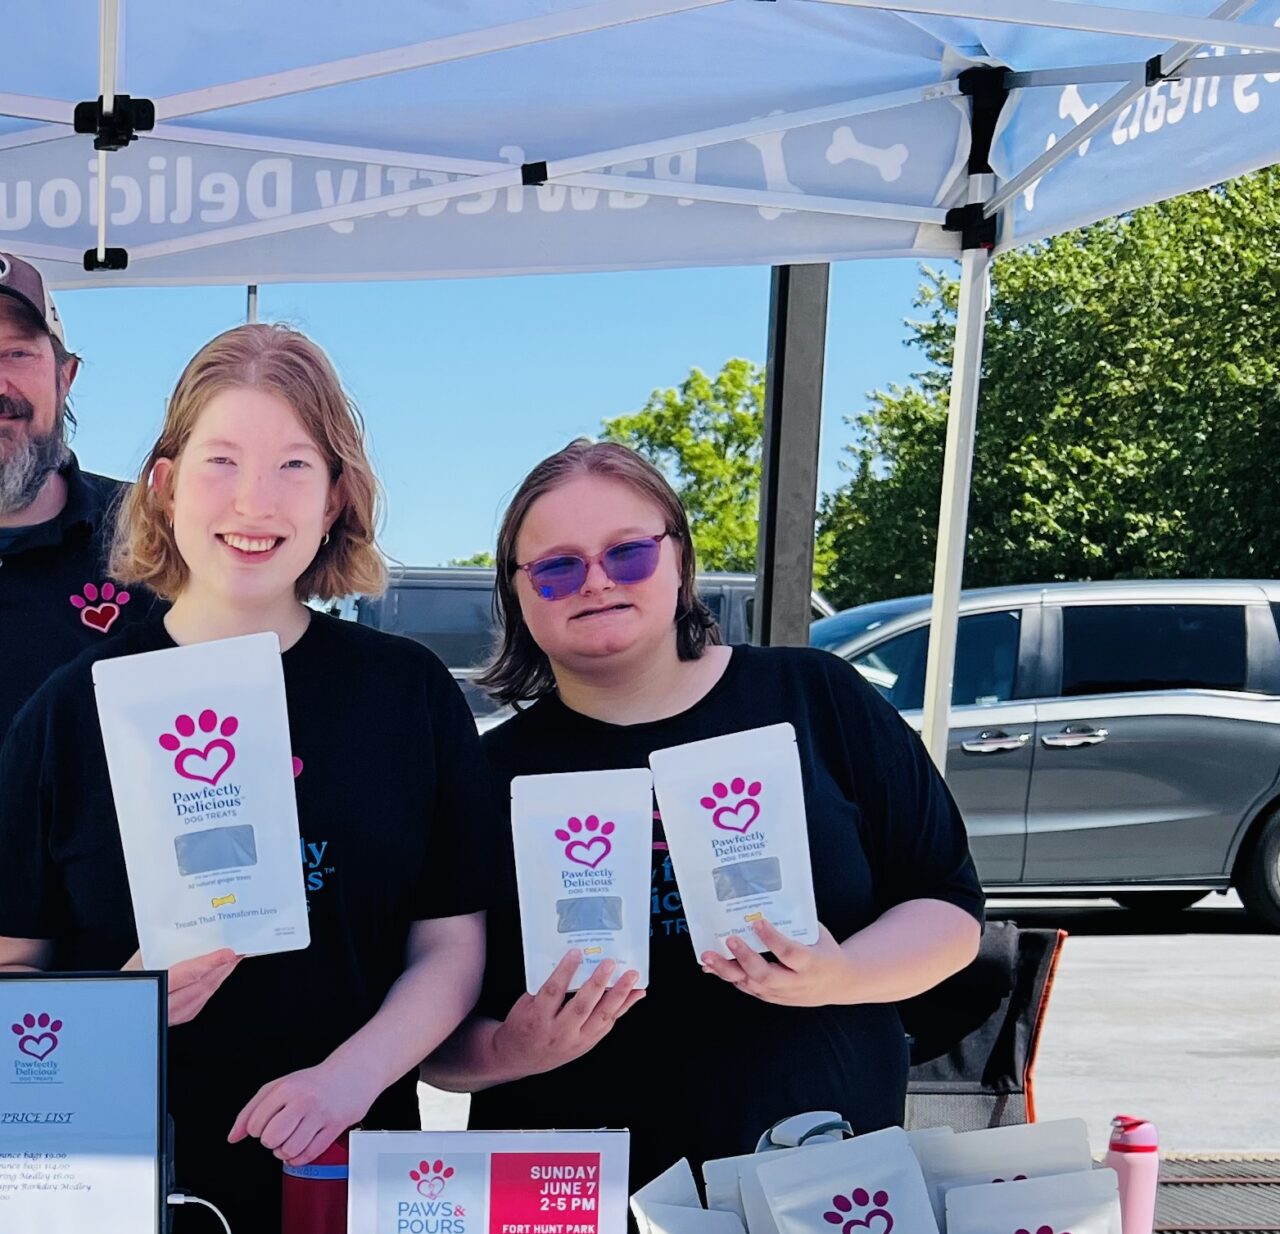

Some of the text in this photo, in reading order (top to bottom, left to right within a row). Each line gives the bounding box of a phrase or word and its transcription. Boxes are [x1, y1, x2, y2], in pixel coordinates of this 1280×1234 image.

[172, 783, 242, 804] Pawfectly
[176, 797, 242, 816] Delicious
[184, 809, 237, 825] DOG TREATS
[711, 831, 766, 848] Pawfectly
[714, 841, 766, 857] Delicious
[561, 868, 613, 880] Pawfectly
[563, 877, 613, 888] Delicious
[217, 909, 260, 921] Transform
[14, 1060, 58, 1069] Pawfectly
[15, 1067, 57, 1076] Delicious
[0, 1111, 77, 1124] PRICE LIST
[530, 1166, 597, 1180] SUNDAY
[540, 1182, 597, 1195] JUNE 7
[540, 1198, 596, 1211] 2-5 PM
[397, 1218, 466, 1234] POURS
[502, 1224, 596, 1234] FORT HUNT PARK
